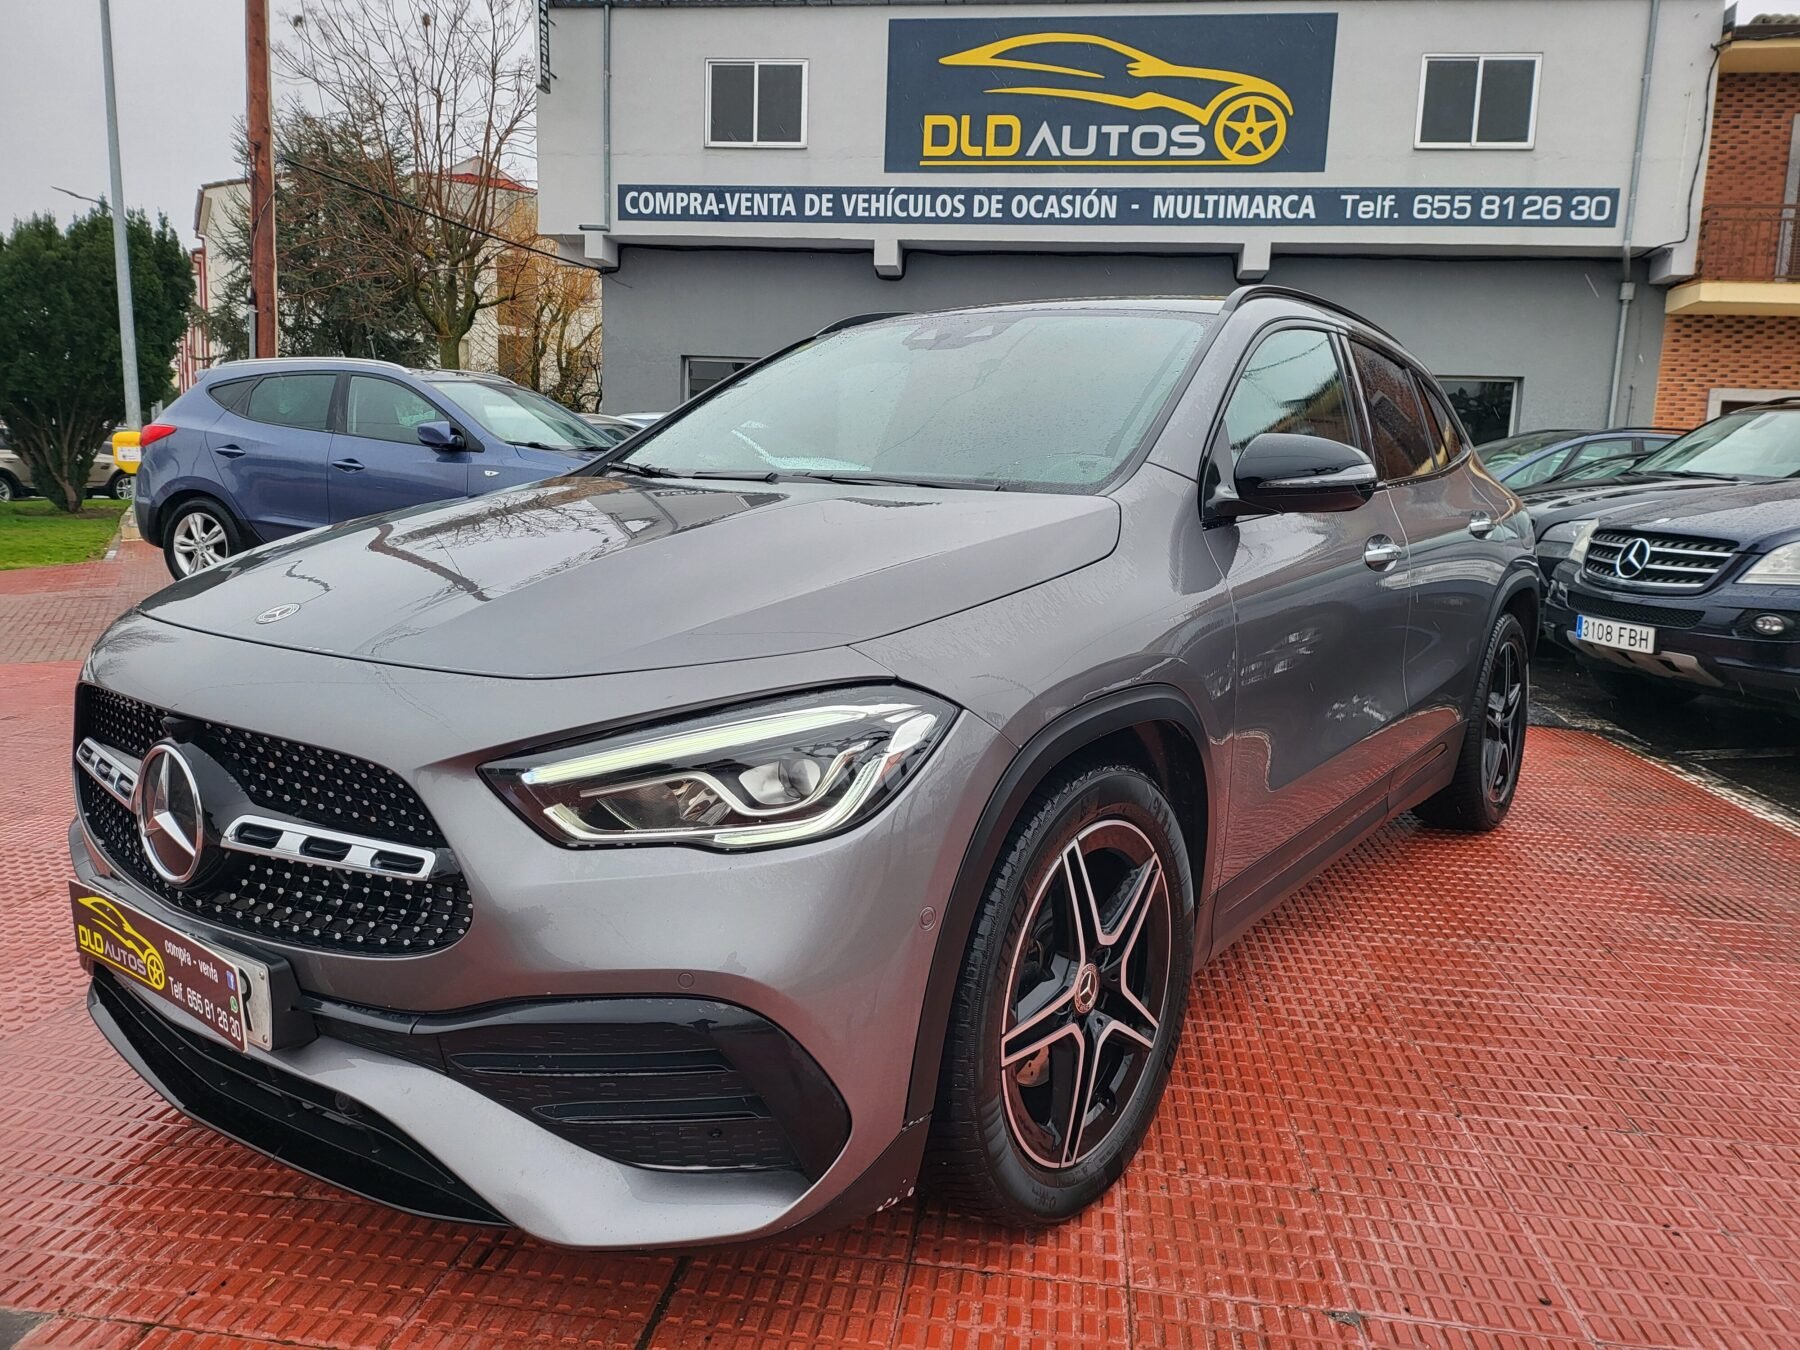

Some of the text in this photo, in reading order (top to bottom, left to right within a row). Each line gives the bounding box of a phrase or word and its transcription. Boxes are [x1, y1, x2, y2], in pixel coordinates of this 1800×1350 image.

[922, 114, 1206, 157] DLD AUTOS
[625, 190, 797, 216] COMPRA-VENTA
[804, 193, 834, 217] DE
[841, 187, 966, 218] VEHÍCULOS
[973, 194, 1004, 218] DE
[1011, 188, 1118, 219] OCASIÓN
[1152, 194, 1316, 219] MULTIMARCA
[1340, 194, 1399, 219] Telf.
[1412, 194, 1472, 220] 655
[1570, 195, 1611, 221] 30
[1583, 619, 1649, 649] 3108 FBH
[78, 924, 147, 976] DLD AUTOS
[164, 939, 192, 967] compra
[198, 959, 219, 984] venta
[168, 975, 242, 1042] Telf. 655 81 26 30
